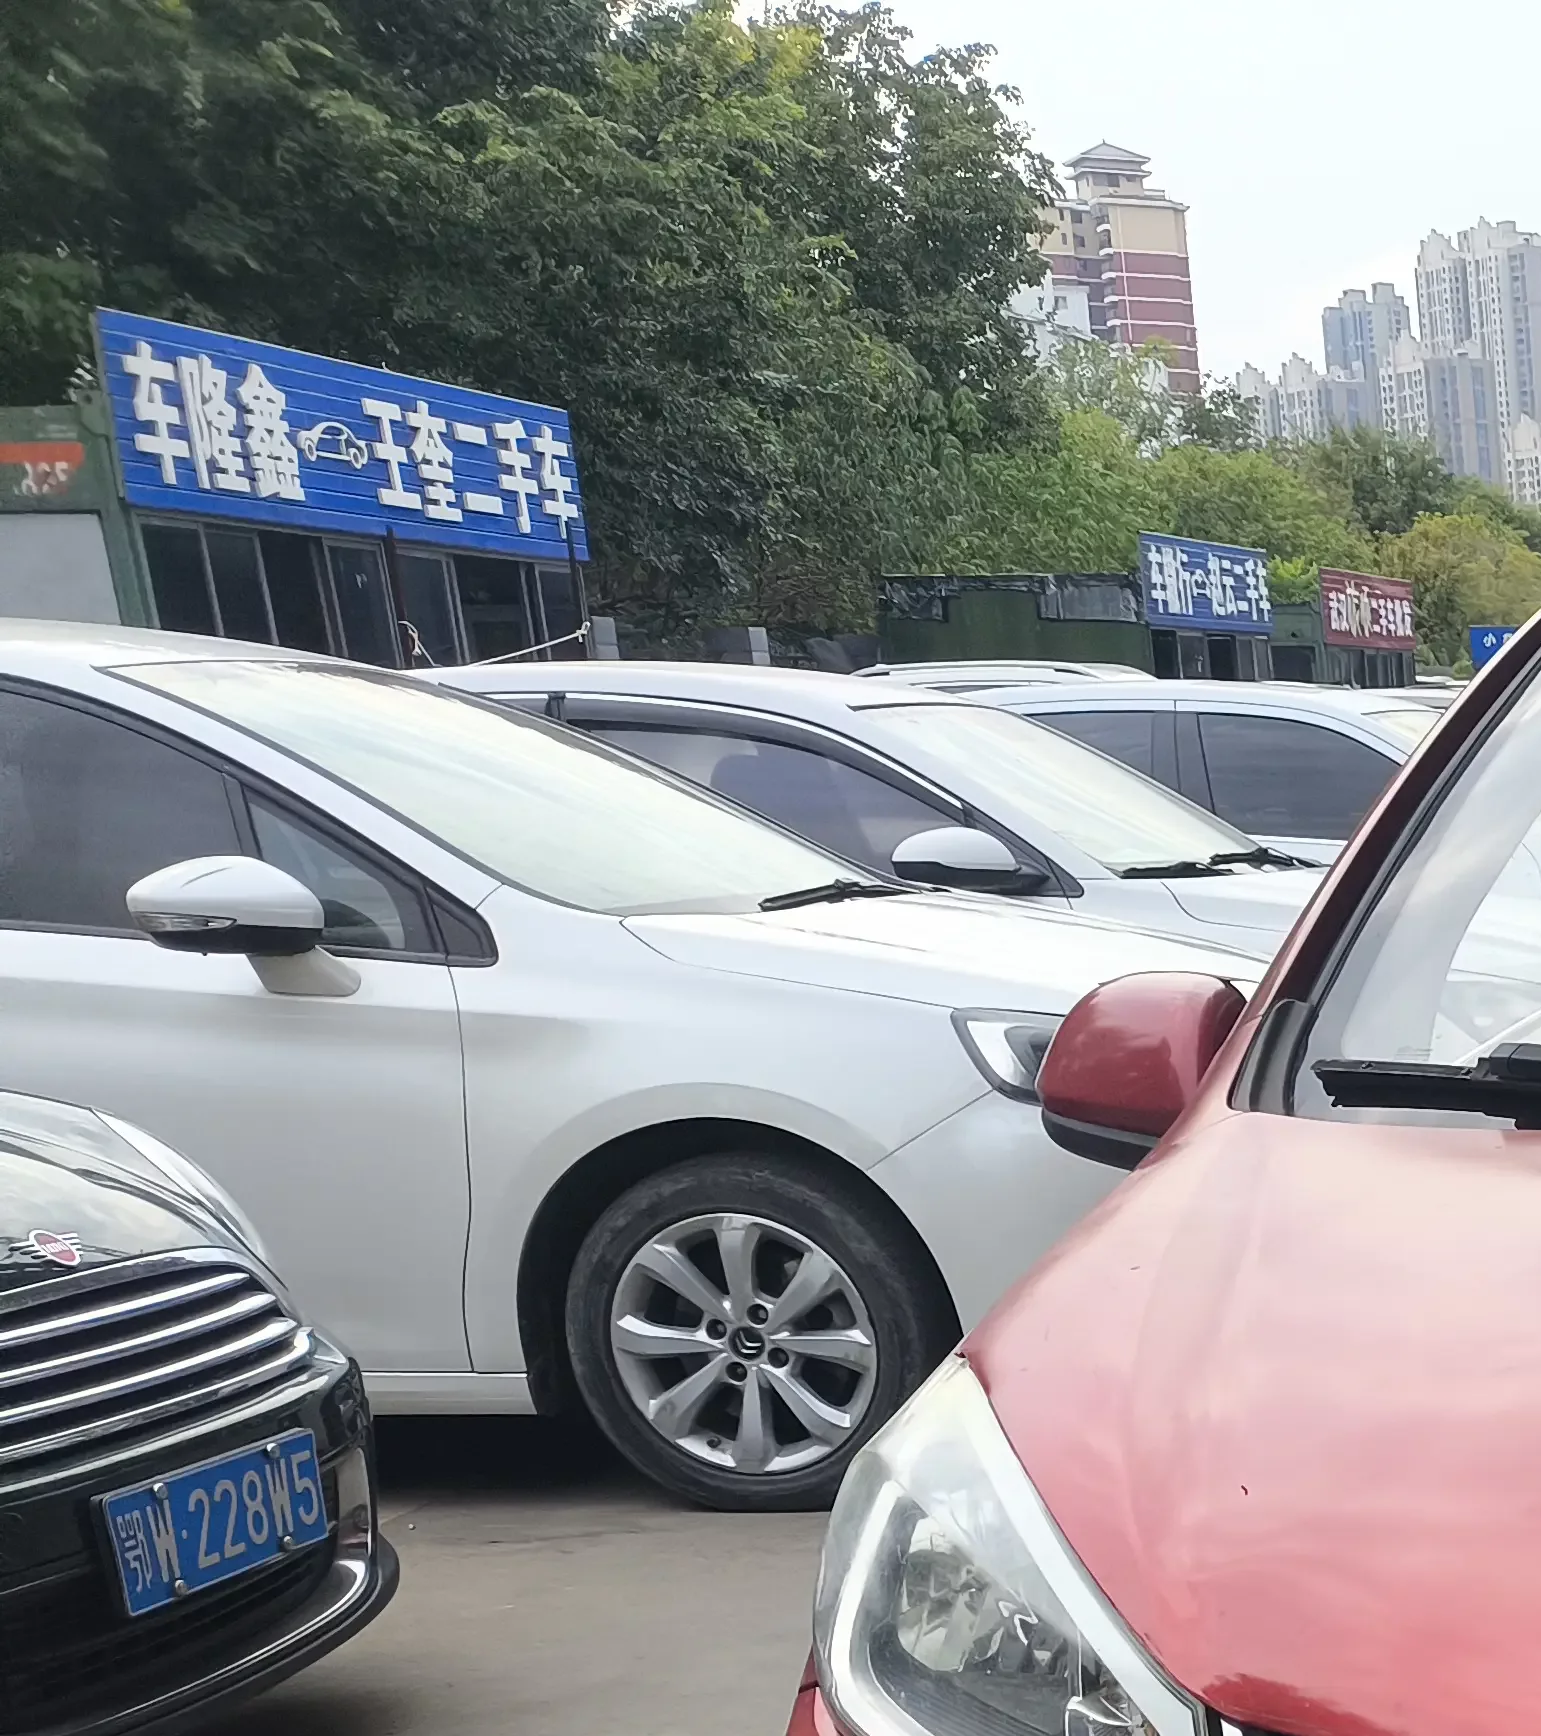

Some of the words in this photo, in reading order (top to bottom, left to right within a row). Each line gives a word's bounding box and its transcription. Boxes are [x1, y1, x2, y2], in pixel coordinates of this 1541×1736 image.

[122, 340, 306, 501] 车隆鑫
[361, 398, 579, 540] 王奎二手车
